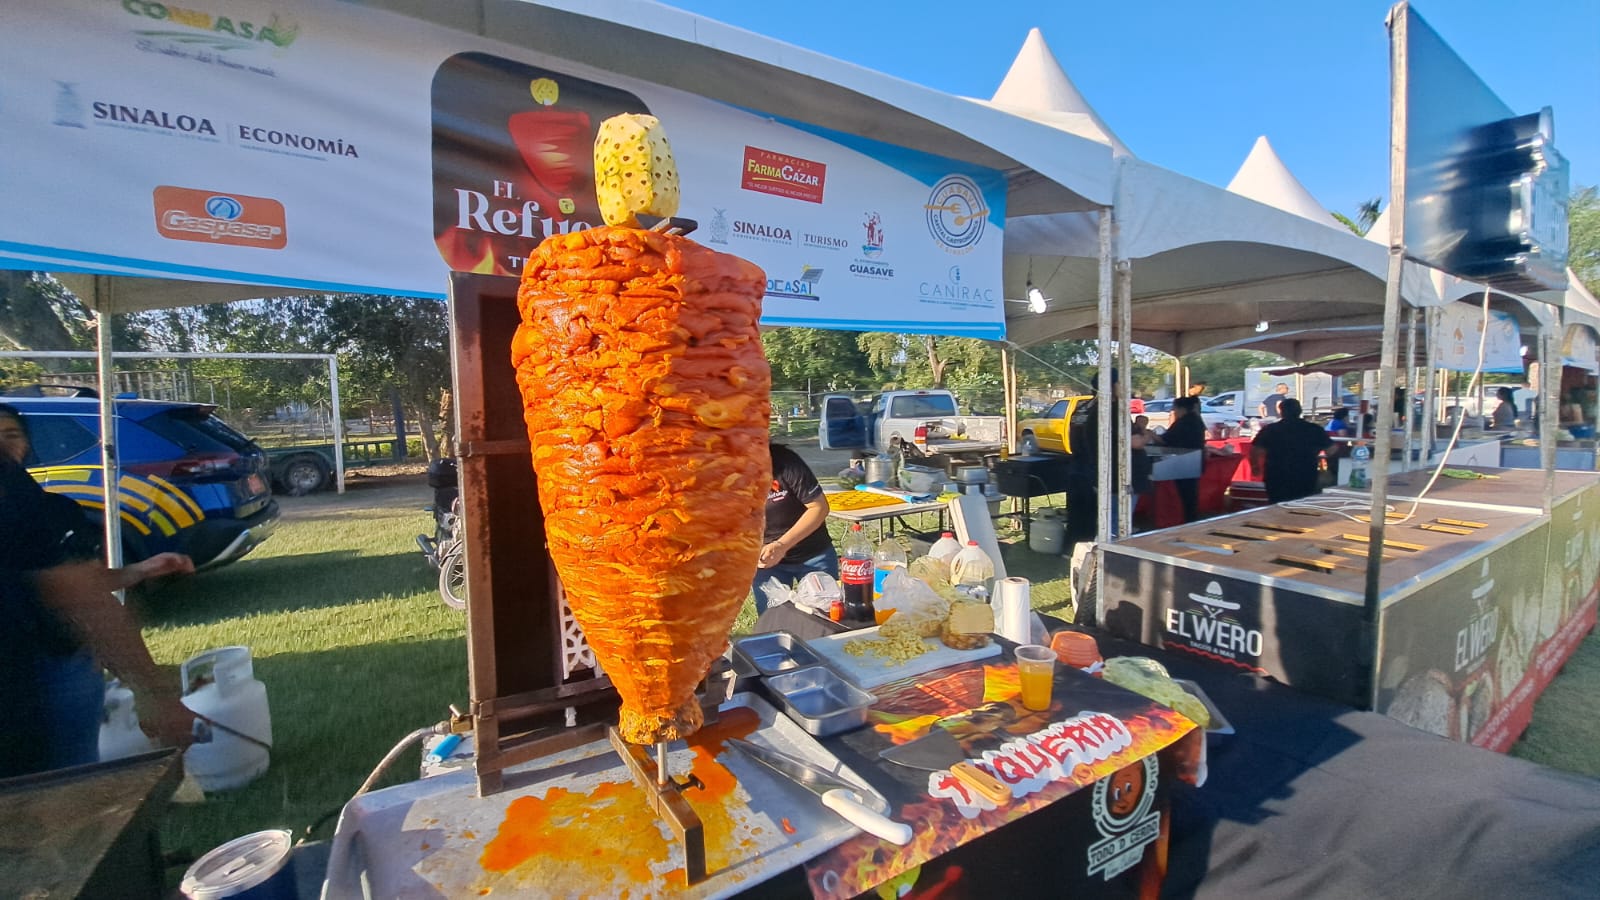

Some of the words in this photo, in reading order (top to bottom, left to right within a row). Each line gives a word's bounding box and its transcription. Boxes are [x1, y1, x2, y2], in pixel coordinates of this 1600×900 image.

[93, 101, 216, 135] SINALOA
[239, 124, 359, 158] ECONOMÍA
[760, 151, 811, 168] FARMACIAS
[494, 180, 517, 199] EL
[937, 186, 977, 210] GUASAVE
[162, 209, 276, 239] Gaspasa
[733, 220, 792, 240] SINALOA
[804, 233, 848, 248] TURISMO
[849, 264, 894, 277] GUASAVE
[920, 282, 993, 301] CANIRAC
[1166, 608, 1192, 638] EL
[1191, 614, 1263, 657] WERO
[938, 714, 1124, 805] TQUERIA
[1091, 843, 1115, 865] TODO
